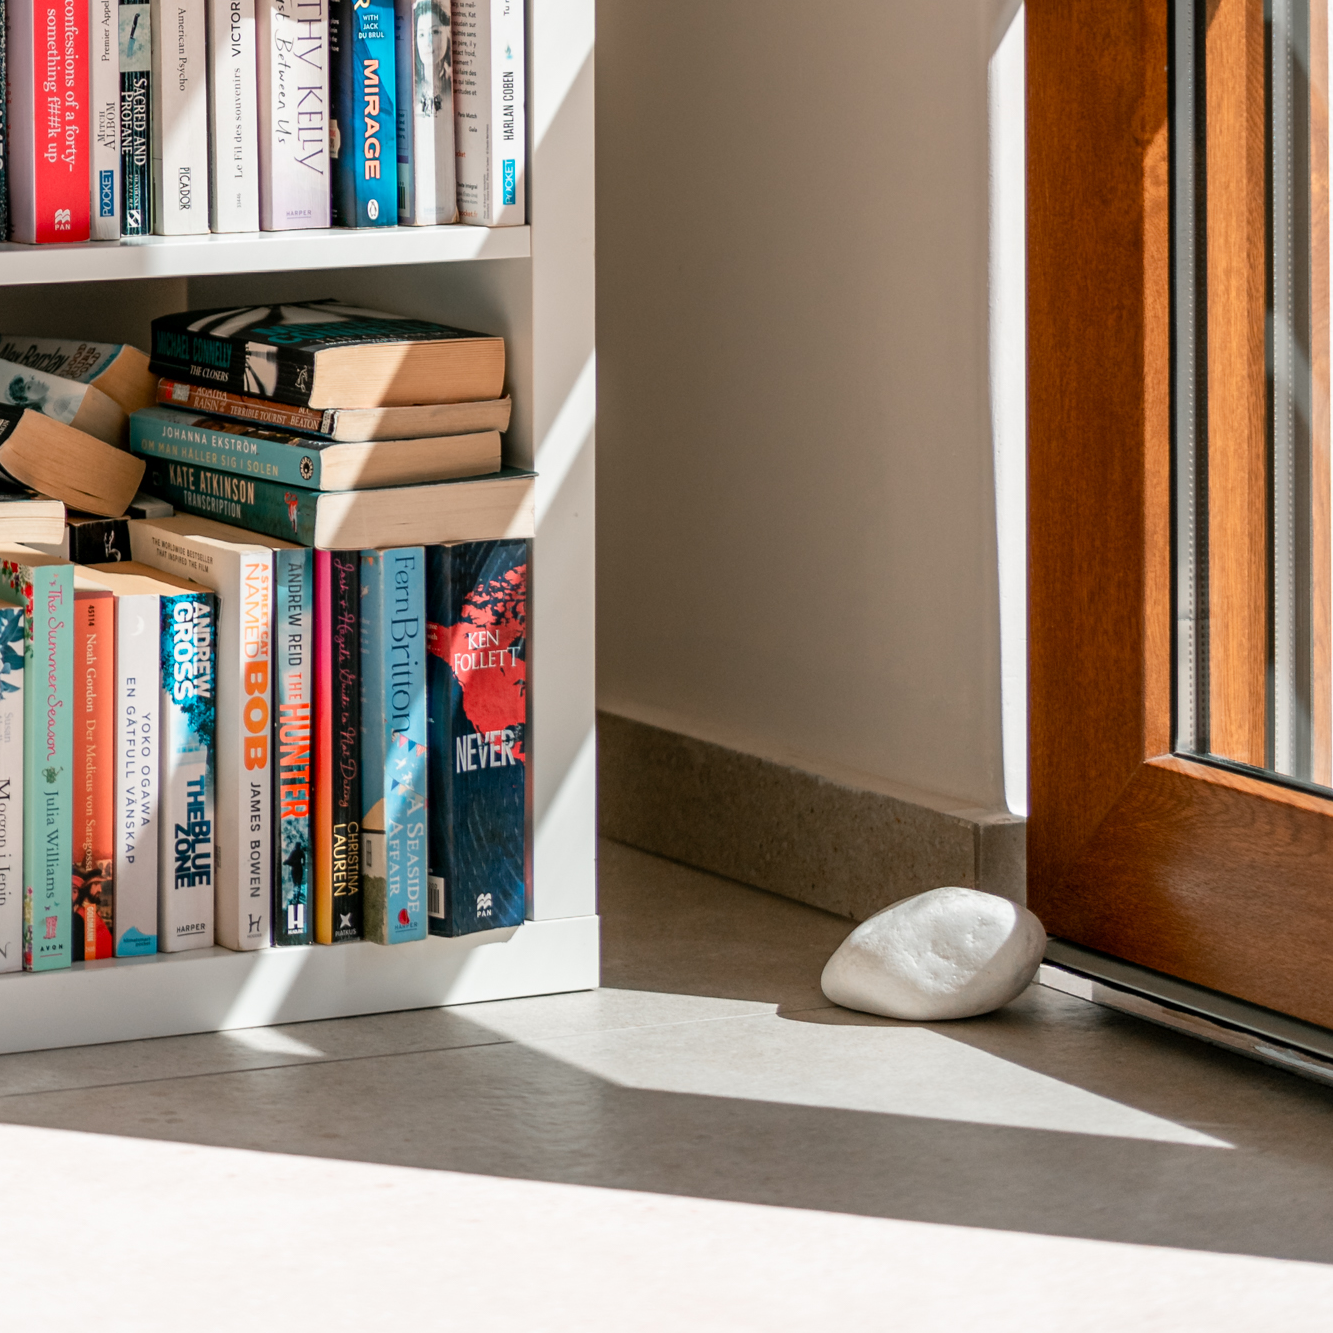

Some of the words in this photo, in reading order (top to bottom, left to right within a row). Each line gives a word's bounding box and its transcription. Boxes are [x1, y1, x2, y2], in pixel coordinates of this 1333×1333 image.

[43, 8, 59, 92] something
[65, 91, 79, 109] of
[503, 71, 514, 101] COBEN
[47, 96, 61, 138] f##k
[296, 85, 324, 176] KELLY
[363, 59, 381, 180] MIRAGE
[503, 104, 514, 141] HARLAN
[44, 144, 57, 163] up
[61, 125, 79, 172] forty-
[100, 170, 114, 217] POCKET
[179, 166, 191, 211] PICADOR
[503, 159, 515, 205] POCKET
[162, 426, 207, 445] JOHANNA
[211, 435, 257, 454] EKSTRÖM
[230, 405, 259, 419] TERRIBLE
[260, 411, 287, 425] TOURIST
[169, 463, 195, 490] KATE
[200, 472, 255, 504] ATKINSON
[184, 490, 241, 519] TRANSCRIPTION
[288, 562, 303, 627] ANDREW
[393, 555, 415, 614] Fern
[245, 563, 260, 659] NAMED
[173, 601, 193, 699] GROSS
[192, 602, 211, 699] ANDREW
[288, 633, 303, 666] REID
[454, 647, 520, 673] FOLLETT
[468, 630, 500, 649] KEN
[126, 677, 136, 697] EN
[288, 672, 303, 700] THE
[391, 614, 420, 734] Britton
[244, 659, 269, 771] BOB
[126, 706, 136, 779] GÅTFULL
[279, 703, 310, 820] HUNTER
[456, 730, 517, 774] NEVER
[43, 789, 59, 827] Julia
[186, 774, 206, 823] THE
[249, 781, 260, 833] JAMES
[126, 787, 136, 864] VÄNSKAP
[43, 832, 60, 900] Williams
[174, 823, 197, 890] ZONE
[191, 820, 211, 886] BLUE
[249, 840, 261, 898] BOWEN
[333, 822, 347, 897] LAUREN
[347, 821, 359, 897] CHRISTINA
[389, 818, 400, 897] AFFAIR
[406, 823, 421, 913] SEASIDE
[176, 923, 206, 933] HARPER
